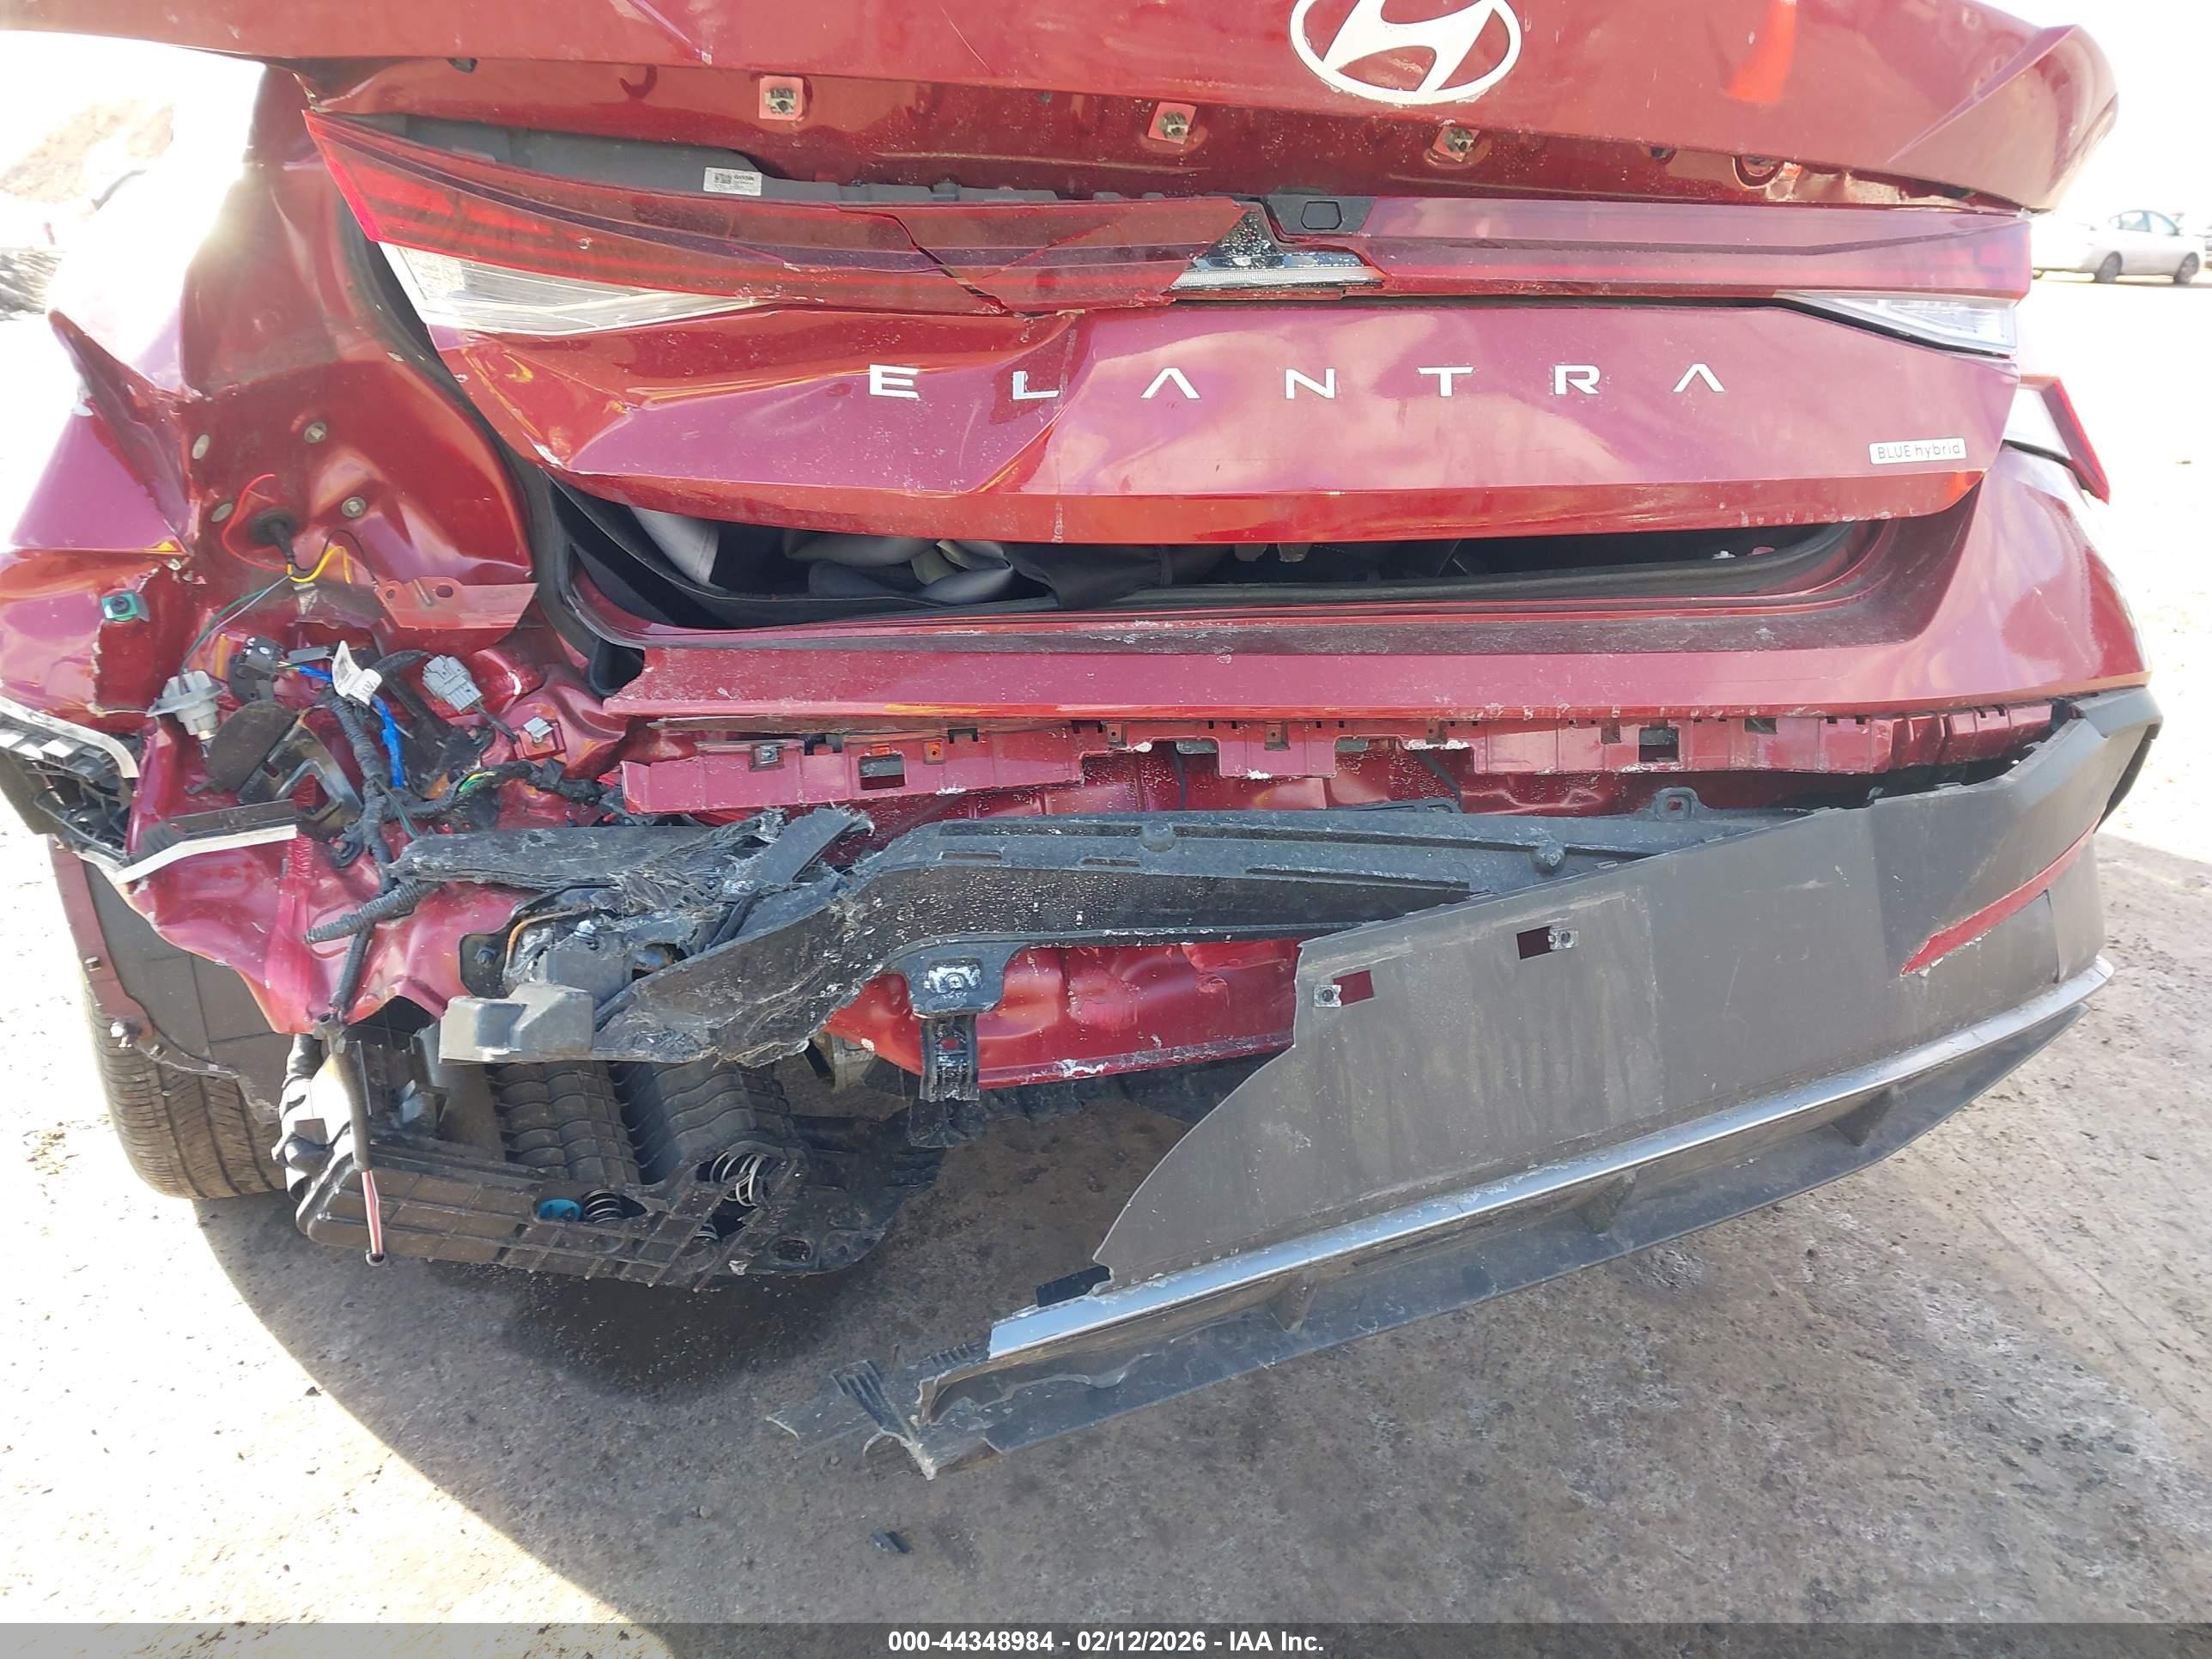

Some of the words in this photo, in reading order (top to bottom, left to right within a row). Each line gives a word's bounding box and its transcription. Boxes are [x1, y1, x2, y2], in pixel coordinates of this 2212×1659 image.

[869, 363, 1725, 401] ELANTRA
[1877, 445, 1911, 459] BLUE
[1915, 442, 1960, 459] hybrid
